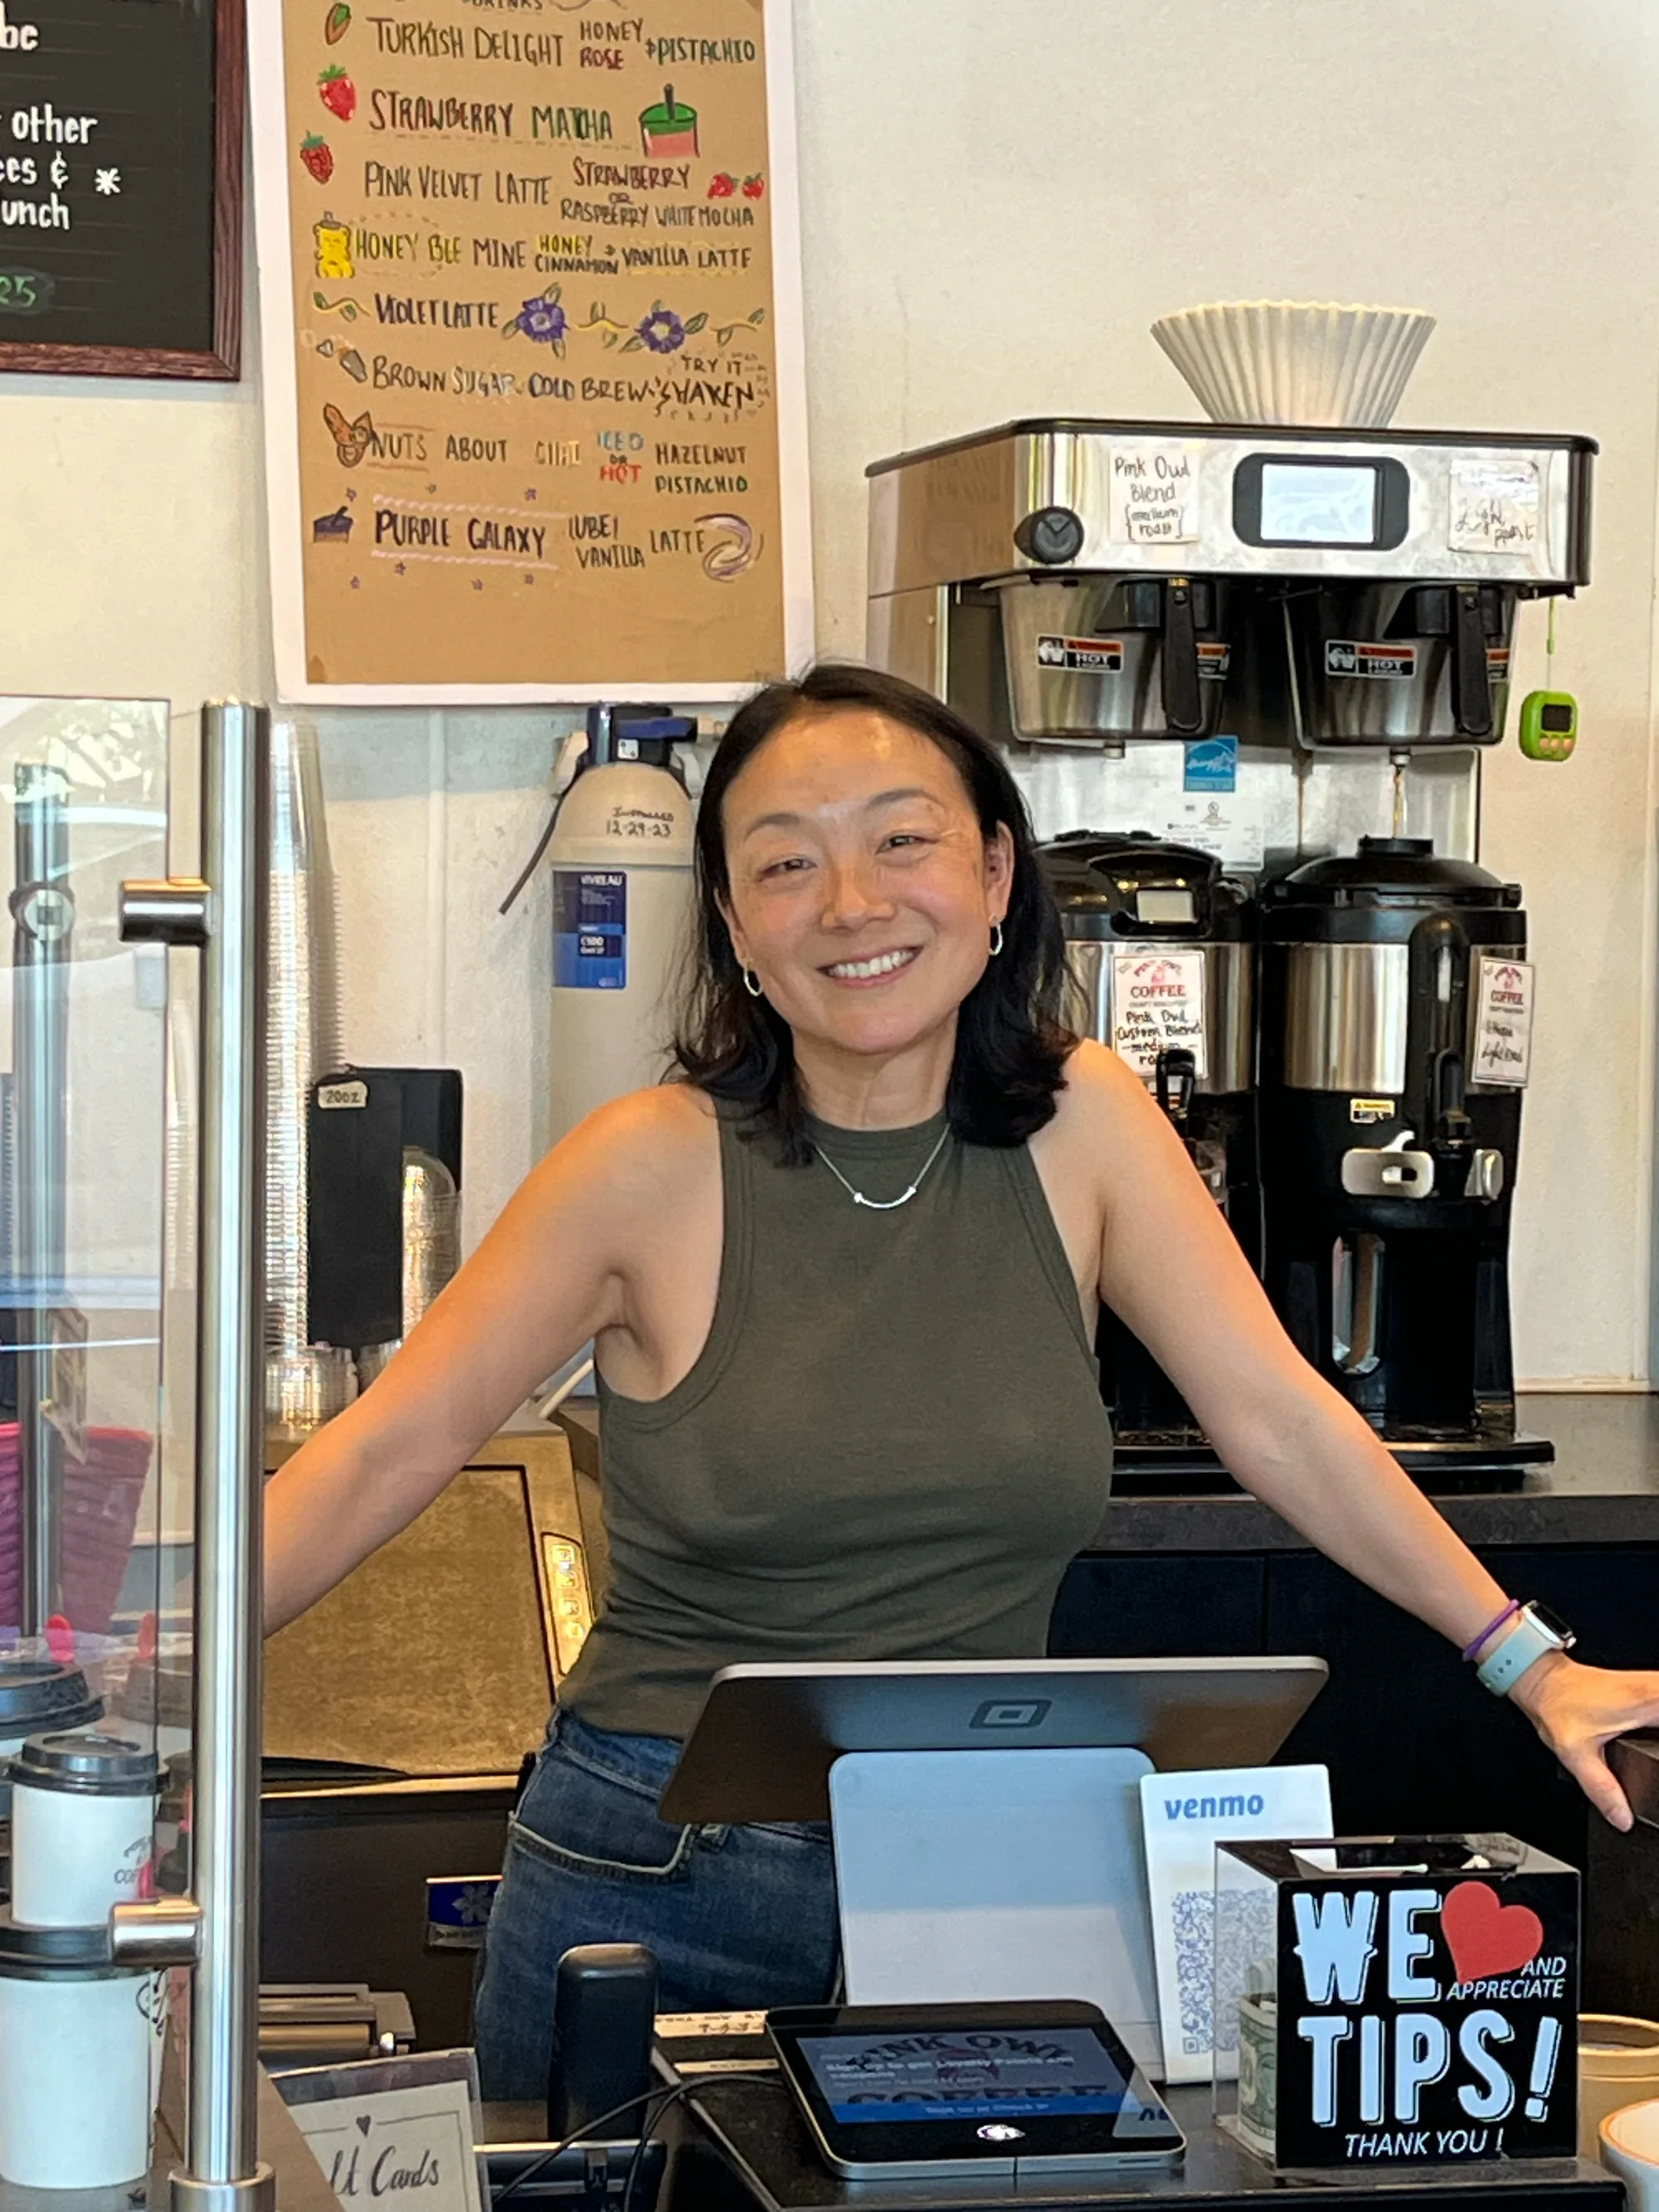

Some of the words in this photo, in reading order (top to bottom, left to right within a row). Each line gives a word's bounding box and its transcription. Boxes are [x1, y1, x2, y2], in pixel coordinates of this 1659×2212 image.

[366, 17, 464, 58] TURKISH
[474, 26, 564, 66] DELIGHT
[580, 17, 644, 42] HONEY
[580, 46, 625, 70] ROSE
[12, 103, 98, 143] other
[369, 89, 513, 136] STRAWBERRY
[365, 160, 412, 197] PINK
[418, 164, 482, 202] VELVET
[495, 169, 552, 206] LATTE
[572, 155, 690, 190] STRAWBERRY
[561, 197, 649, 227] RASPBERRY
[698, 206, 754, 227] MOCHA
[355, 228, 418, 262] HONEY
[428, 233, 461, 264] BEE
[473, 236, 527, 269] MINE
[538, 234, 593, 257] HONEY
[621, 246, 689, 266] VANILLA
[698, 247, 752, 269] LATTE
[534, 254, 620, 275] CINNAMON
[375, 293, 440, 325] VIOLET
[443, 299, 499, 328] LATTE
[372, 354, 445, 391] BROWN
[528, 372, 576, 401] COLD
[581, 377, 649, 402] BREW
[681, 355, 718, 373] TRY
[727, 361, 742, 377] IT
[372, 431, 427, 461] NUTS
[445, 434, 507, 463] ABOUT
[597, 430, 644, 451] ICED
[655, 443, 747, 465] HAZELNUT
[600, 464, 642, 484] HOT
[655, 475, 748, 494] PISTACHIO
[375, 509, 450, 546] PURPLE
[468, 518, 546, 559] GALAXY
[649, 529, 705, 554] LATTE
[576, 544, 645, 569] VANILLA
[1131, 984, 1186, 999] COFFEE
[1165, 1794, 1264, 1820] venmo
[1292, 1889, 1442, 2005] WE
[1520, 1957, 1567, 1976] AND
[1446, 1977, 1566, 2001] APPRECIATE
[1297, 2010, 1562, 2127] TIPS!
[1345, 2132, 1431, 2157] THANK
[1437, 2128, 1488, 2153] YOU
[372, 2145, 439, 2197] Cards
